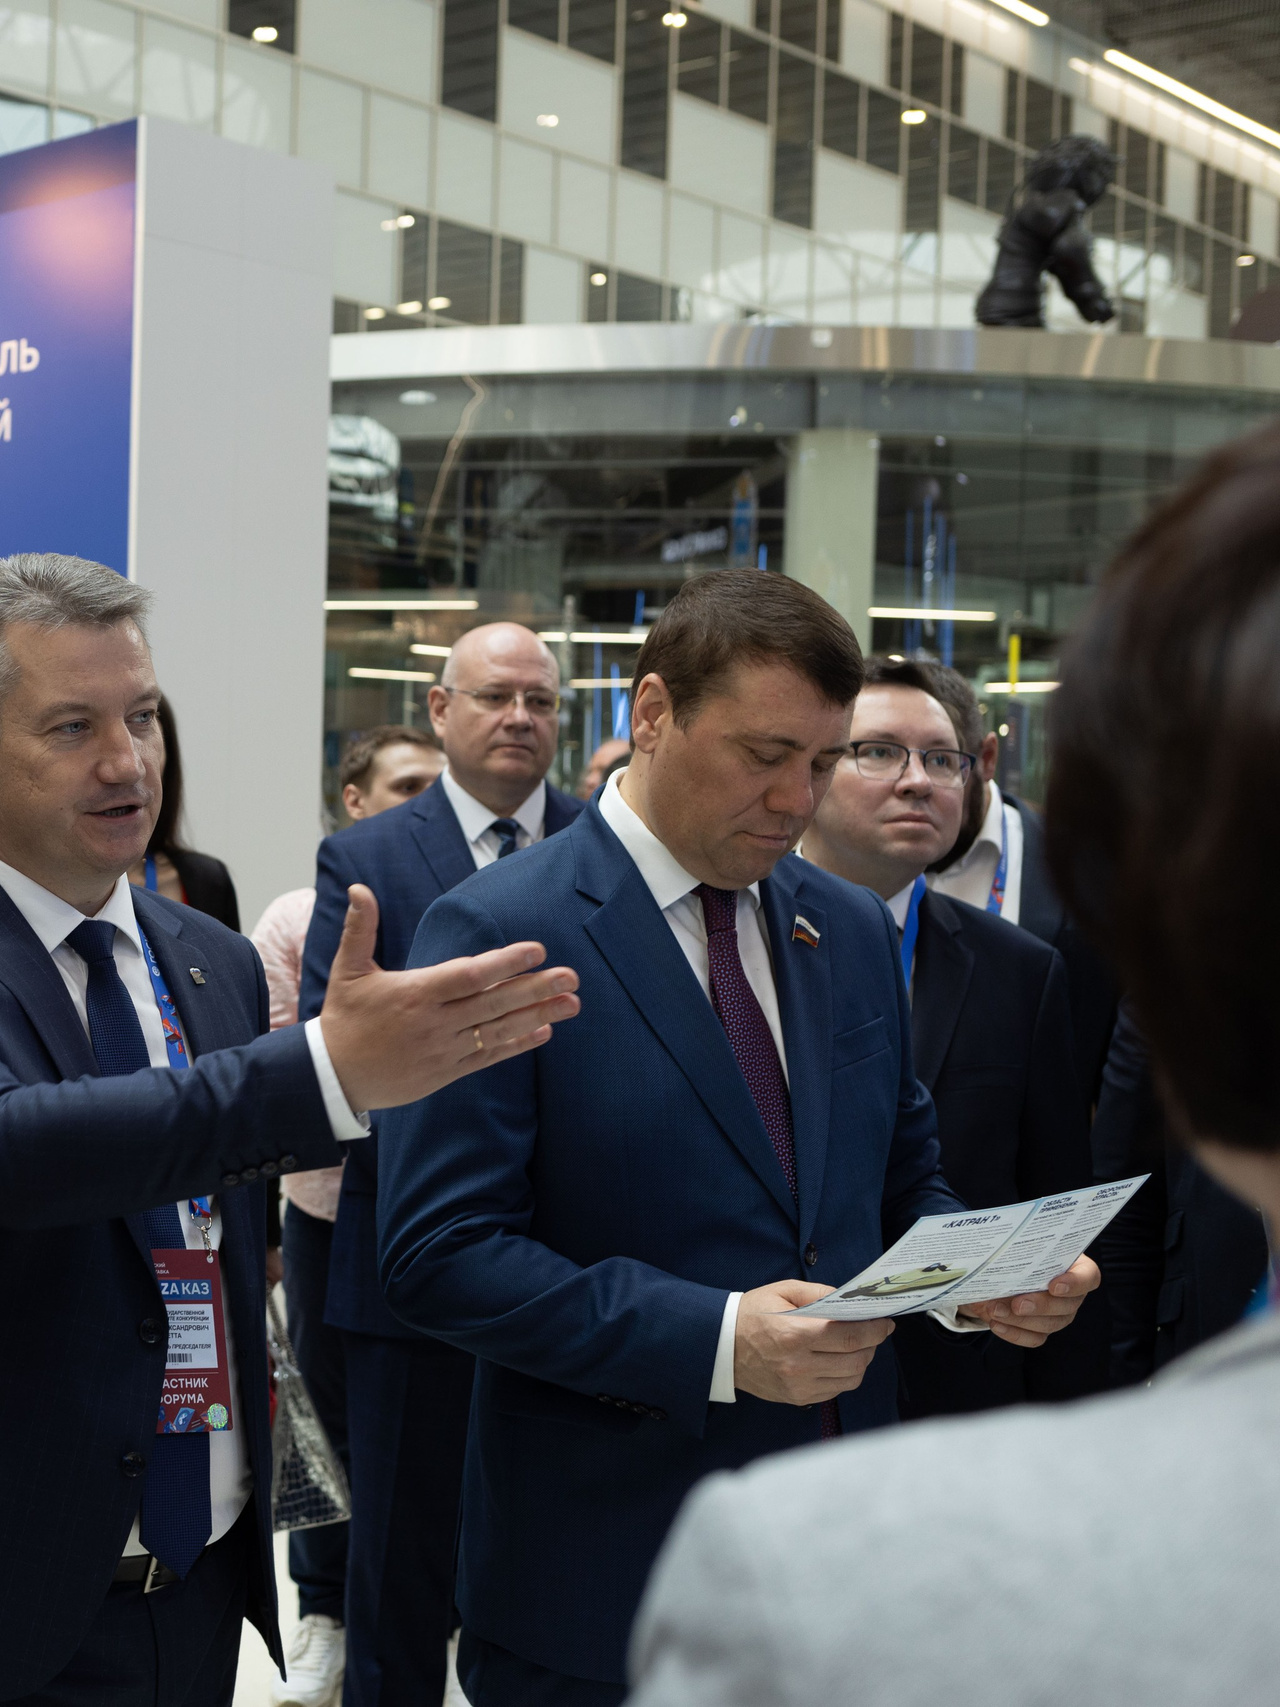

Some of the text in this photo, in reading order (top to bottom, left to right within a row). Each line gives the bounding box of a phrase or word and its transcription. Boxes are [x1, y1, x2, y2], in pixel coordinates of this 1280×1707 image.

[942, 1215, 989, 1229] «КАТРАН
[162, 1377, 209, 1389] АСТНИК
[160, 1393, 205, 1405] ОРУМА
